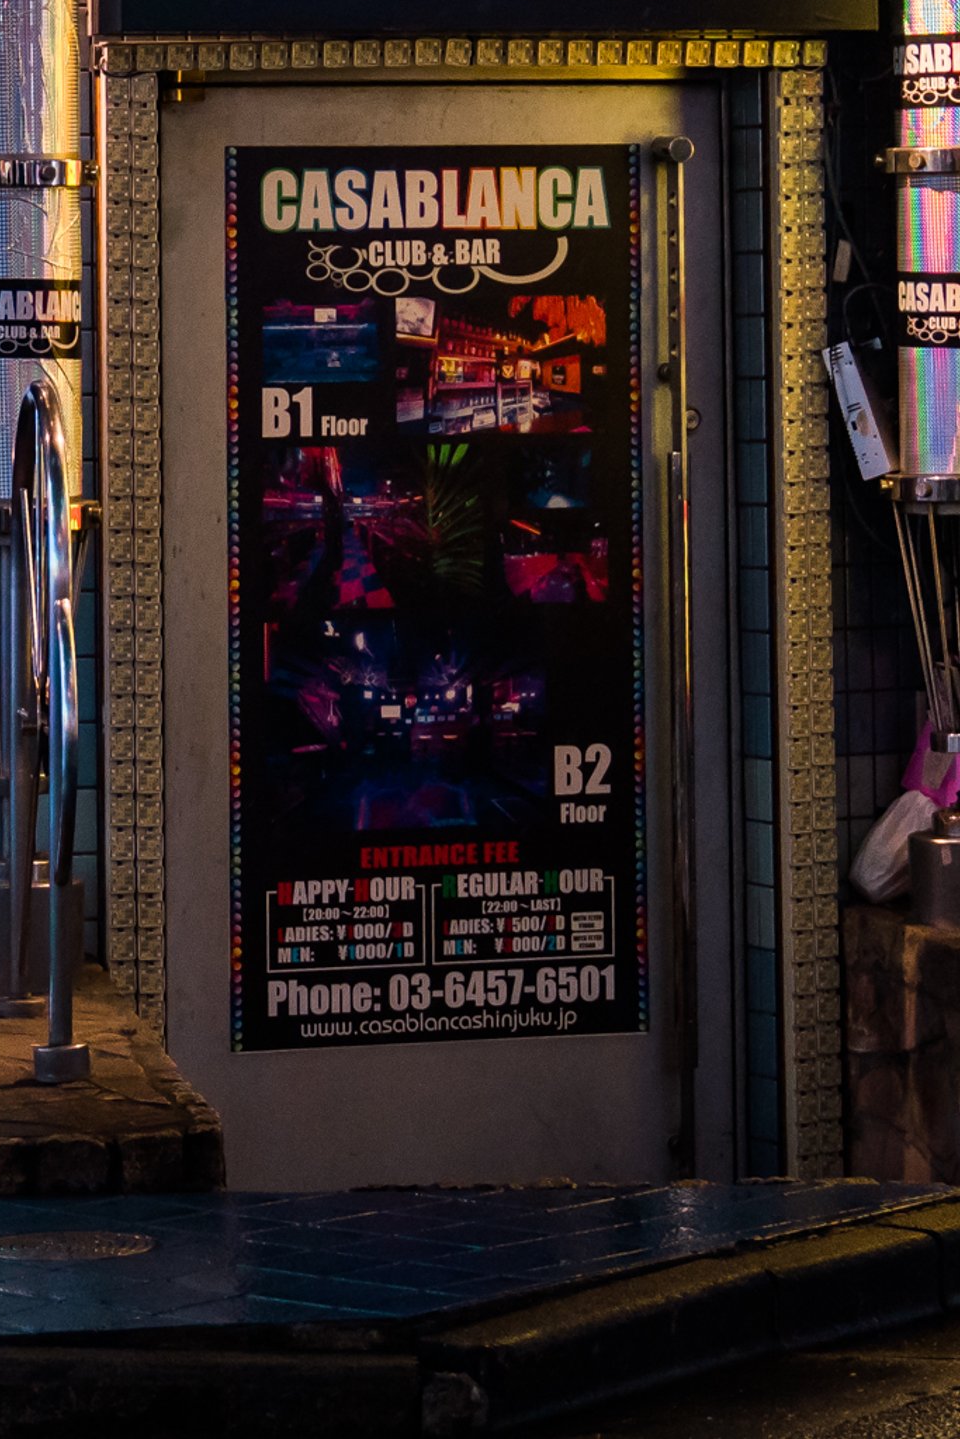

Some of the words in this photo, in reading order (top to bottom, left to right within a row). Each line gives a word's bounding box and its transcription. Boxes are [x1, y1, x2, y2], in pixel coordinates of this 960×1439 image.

[261, 165, 611, 232] CASABLANCA
[368, 240, 426, 267] CLUB
[431, 242, 450, 266] &
[455, 239, 501, 264] BAR
[929, 316, 956, 330] CLUB
[262, 386, 313, 438] B1
[321, 415, 368, 436] Floor
[554, 743, 612, 796] B2
[560, 802, 607, 824] Floor
[361, 842, 478, 869] ENTRANCE
[483, 841, 520, 864] FEE
[278, 946, 315, 963] MEN:
[443, 939, 477, 956] MEN:
[267, 978, 382, 1017] Phone:
[388, 964, 615, 1011] 03-6457-6501
[300, 1007, 578, 1038] www.casablancashinjuku.jp
